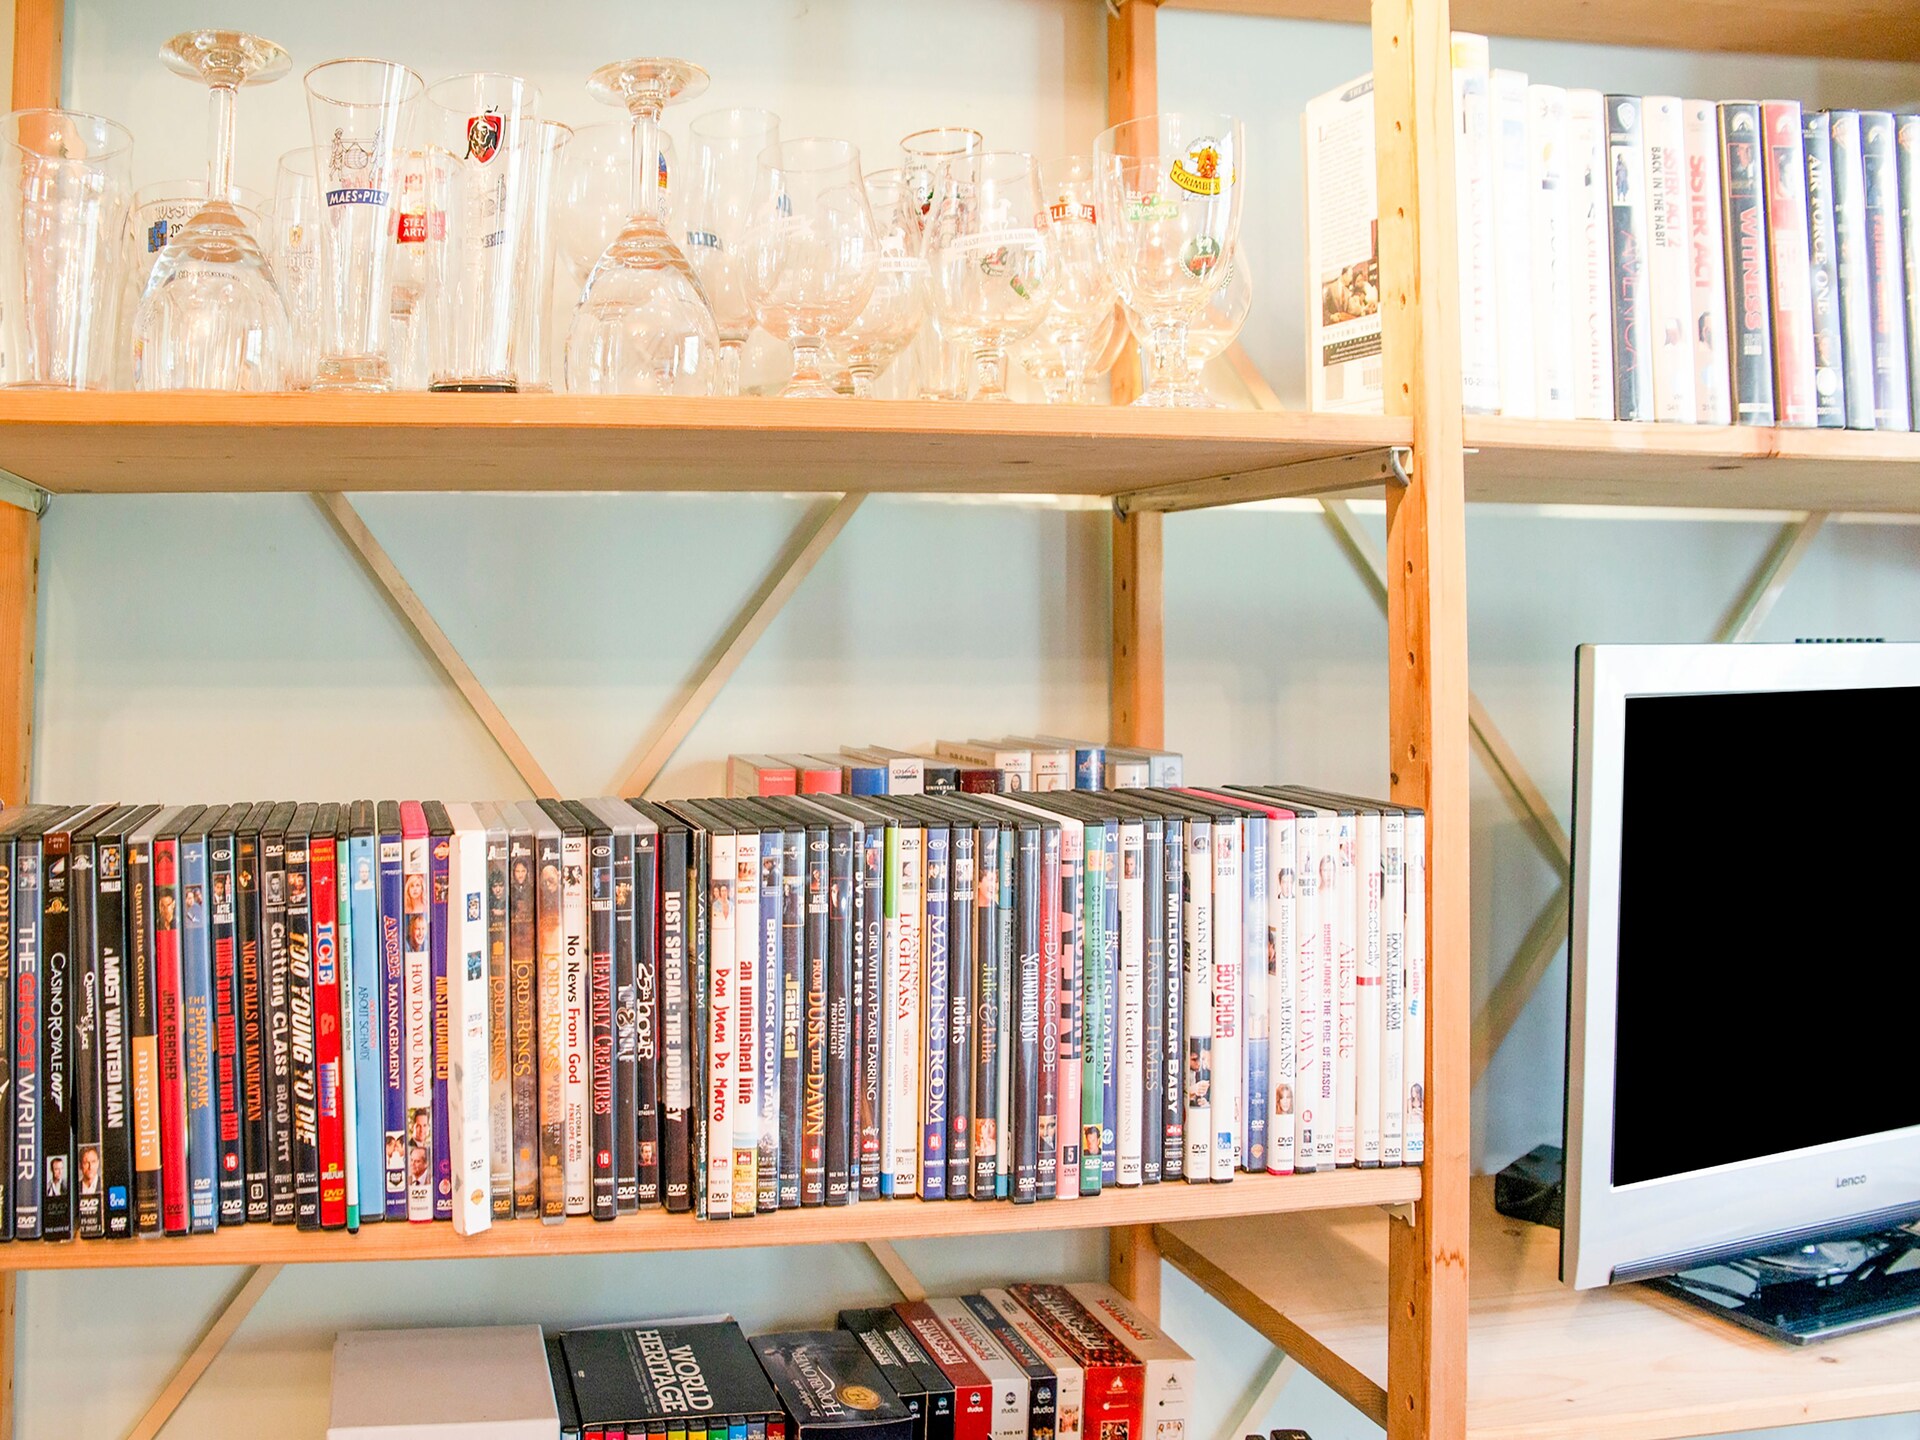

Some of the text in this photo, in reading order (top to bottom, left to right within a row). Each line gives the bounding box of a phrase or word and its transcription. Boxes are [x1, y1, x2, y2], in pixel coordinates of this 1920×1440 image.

[329, 190, 385, 205] MAES PILS
[1651, 146, 1666, 247] BACK IN THE HABIT
[1689, 155, 1713, 288] SISTER ACT
[1808, 155, 1830, 315] AIR FORCE ONE
[1740, 206, 1762, 330] WITNESS
[134, 883, 146, 1017] QUALITY FILM COLLECTION
[316, 922, 334, 985] ICE
[697, 952, 706, 1008] VEUM
[765, 919, 776, 1028] BROKEBACK
[854, 871, 864, 1007] DVD TOPPERS
[898, 912, 913, 1020] LUGHNASA
[980, 963, 997, 1002] Julie
[1044, 942, 1057, 964] DA
[1197, 906, 1207, 984] RAIN MAN
[48, 952, 66, 1112] CASINO ROYALE 007
[83, 971, 96, 1018] QUANTUM
[220, 1016, 234, 1056] DENVER
[243, 941, 261, 1121] NIGHT FALLS ON MANHATTAN
[358, 986, 370, 1061] ABOUT SCHMIDT
[384, 916, 400, 1089] ANGER MANAGEMENT
[411, 963, 425, 1097] HOW DO YOU KNOW
[568, 935, 581, 1084] No News From God
[593, 952, 612, 1114] HEAVENLY CREATURES
[665, 891, 682, 1122] LOST SPECIAL: THE JOURNEY
[738, 961, 754, 1105] an unfinished life
[784, 974, 799, 1059] Jackal
[837, 997, 846, 1059] MOTHMAN
[866, 922, 879, 1100] GIRL WITH A PEARL EARRING
[929, 914, 946, 1124] MARVIN'S ROOM
[952, 996, 965, 1044] HOURS
[1044, 963, 1057, 1018] VINCI
[1085, 973, 1096, 1064] TOM HANKS
[1124, 959, 1139, 1068] The Reader
[1146, 937, 1162, 1091] HARD TIMES
[1167, 893, 1178, 1113] MILLION DOLLAR BABY
[1322, 1000, 1332, 1016] THE
[1322, 1020, 1332, 1043] EDGE
[18, 922, 36, 1180] THE GHOST WRITER
[104, 947, 122, 1128] A MOST WANTED MAN
[188, 996, 209, 1107] THE SHAWSHANK
[189, 1007, 197, 1110] REDEMPTION
[290, 932, 316, 1147] TOO YOUNG TO DIE
[514, 1019, 532, 1076] RINGS
[712, 968, 730, 1122] Don Juan De Marco
[806, 959, 824, 1136] FROM DUSK TILL DAWN
[980, 1025, 995, 1064] Julia
[1042, 1023, 1056, 1073] CODE
[1279, 996, 1292, 1077] MORGANS?
[1322, 1047, 1332, 1059] OF
[1322, 1061, 1332, 1099] REASON
[135, 1050, 154, 1157] magnolia
[221, 1113, 237, 1141] DEAD
[274, 1011, 289, 1162] CLASS BRAD PITT
[320, 1057, 338, 1118] THIRST
[224, 1155, 236, 1168] 16
[599, 1152, 612, 1167] 16
[1067, 1149, 1074, 1162] 5
[1836, 1174, 1867, 1188] Lenco
[636, 1329, 687, 1413] HERITAGE
[670, 1343, 714, 1411] WORLD
[792, 1348, 846, 1417] HORNBLOWER
